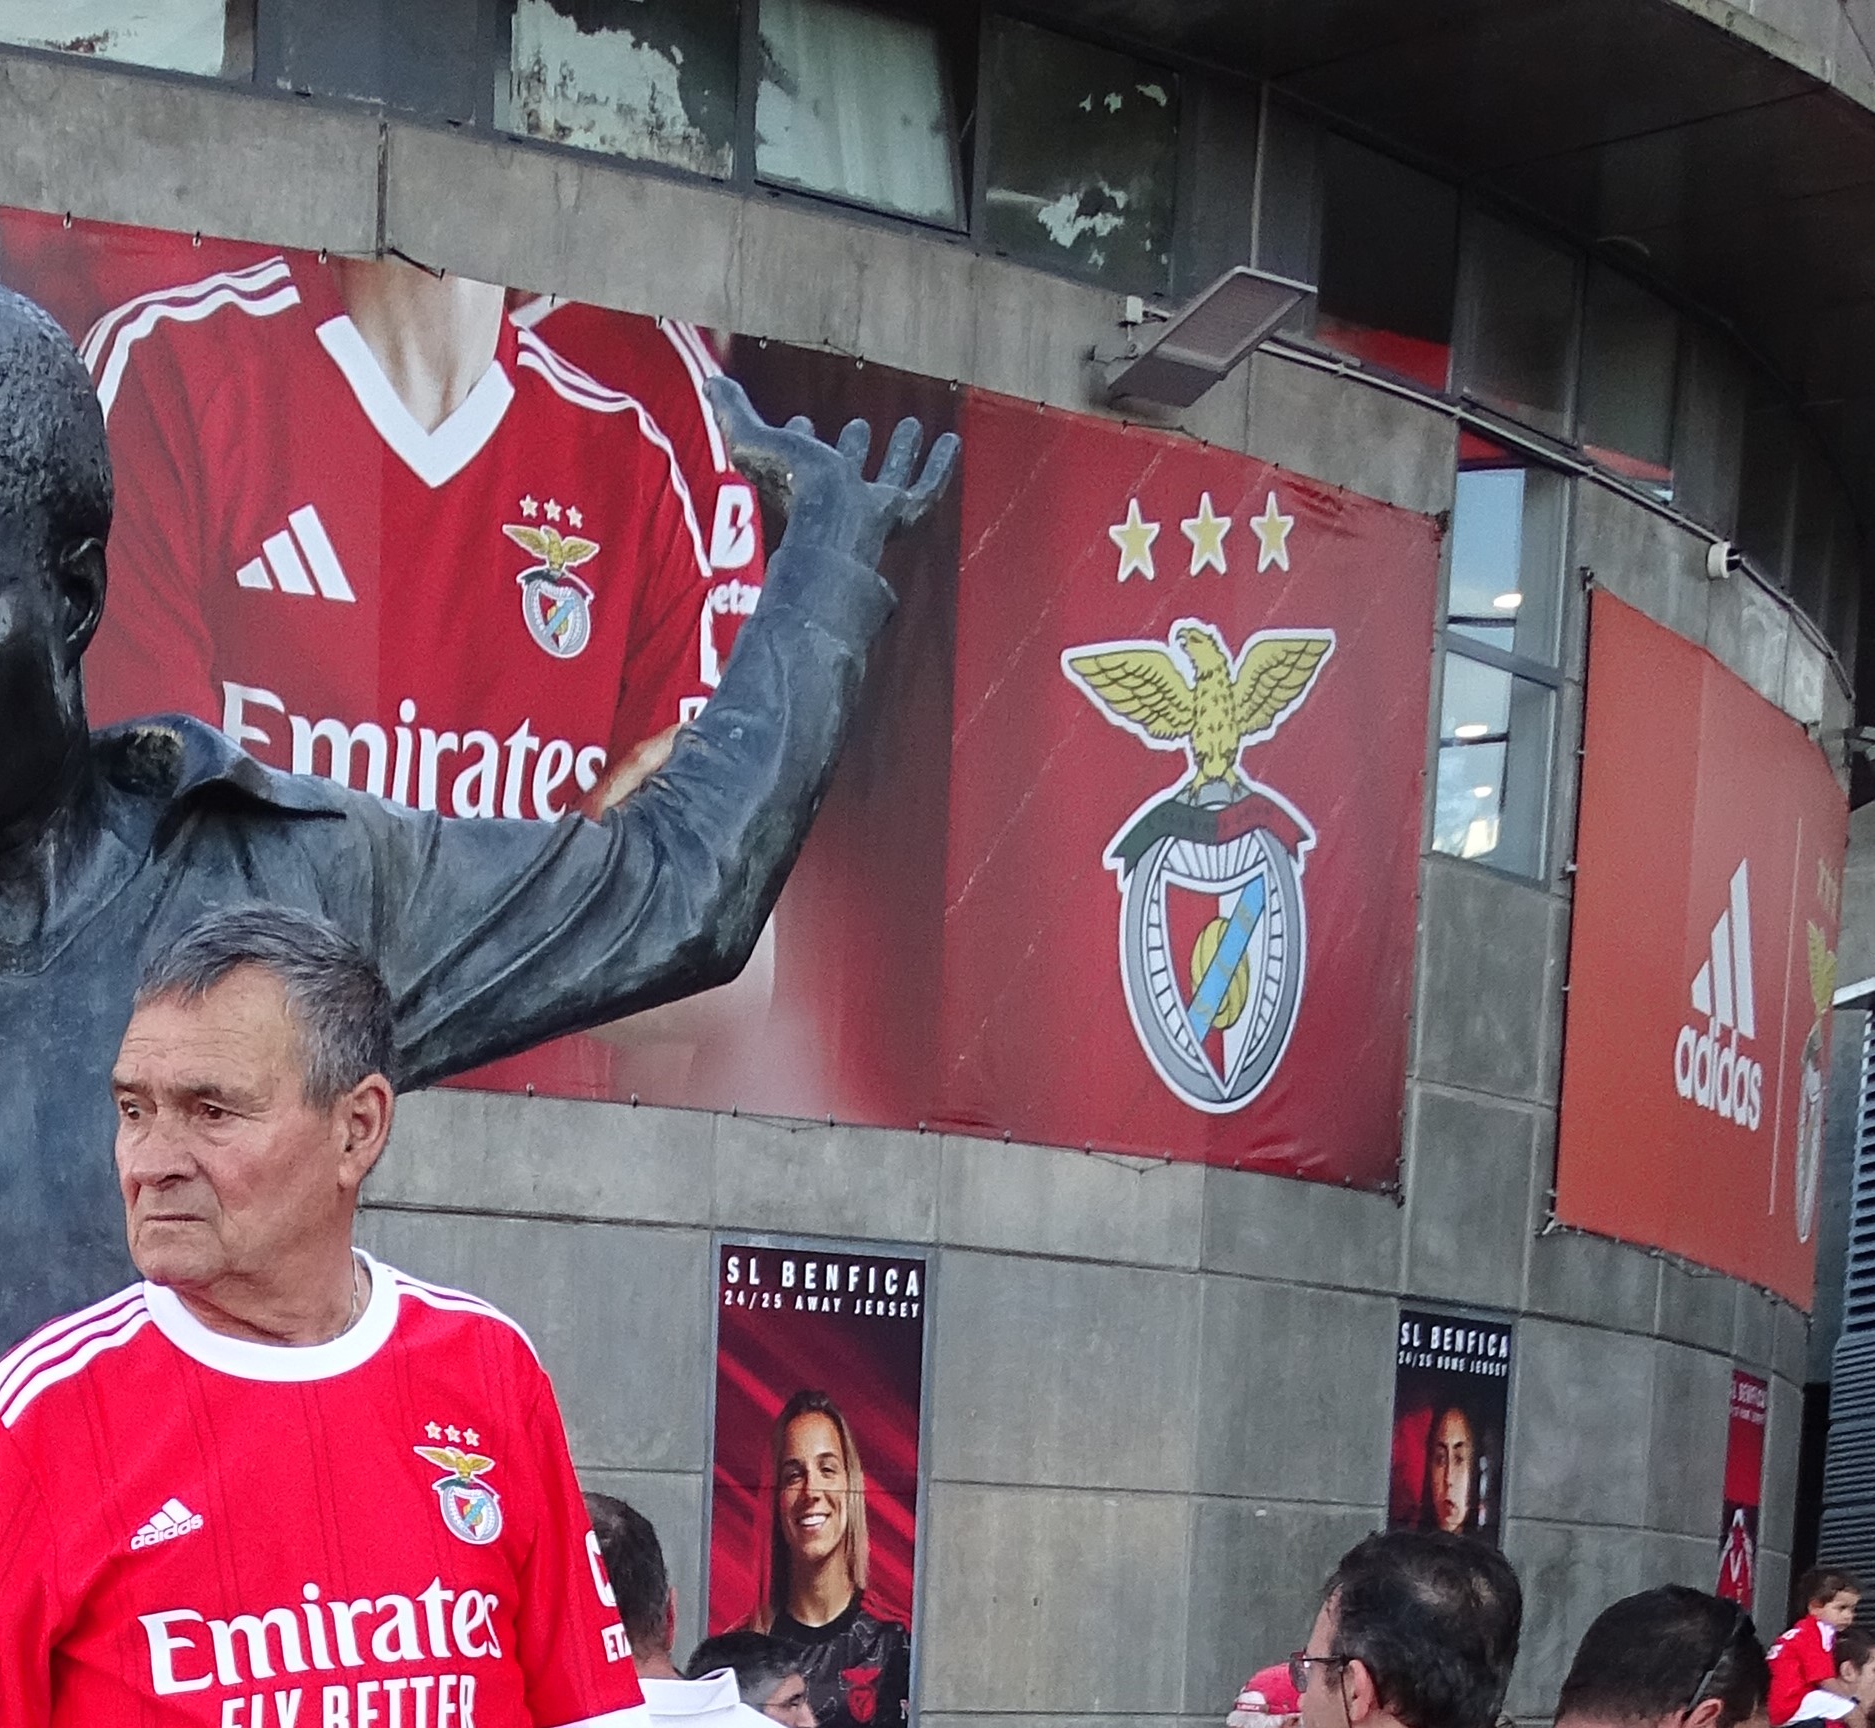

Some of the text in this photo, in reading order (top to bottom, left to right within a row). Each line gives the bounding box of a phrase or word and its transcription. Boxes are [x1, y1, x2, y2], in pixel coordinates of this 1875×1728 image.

[220, 681, 608, 820] Emirates
[1675, 1022, 1762, 1131] adidas
[727, 1257, 920, 1297] SL BENFICA
[725, 1290, 919, 1317] 24/25 AWAY JERSEY
[1401, 1322, 1509, 1359] SL BENFICA
[130, 1514, 204, 1550] adidas
[138, 1577, 502, 1695] Emirates
